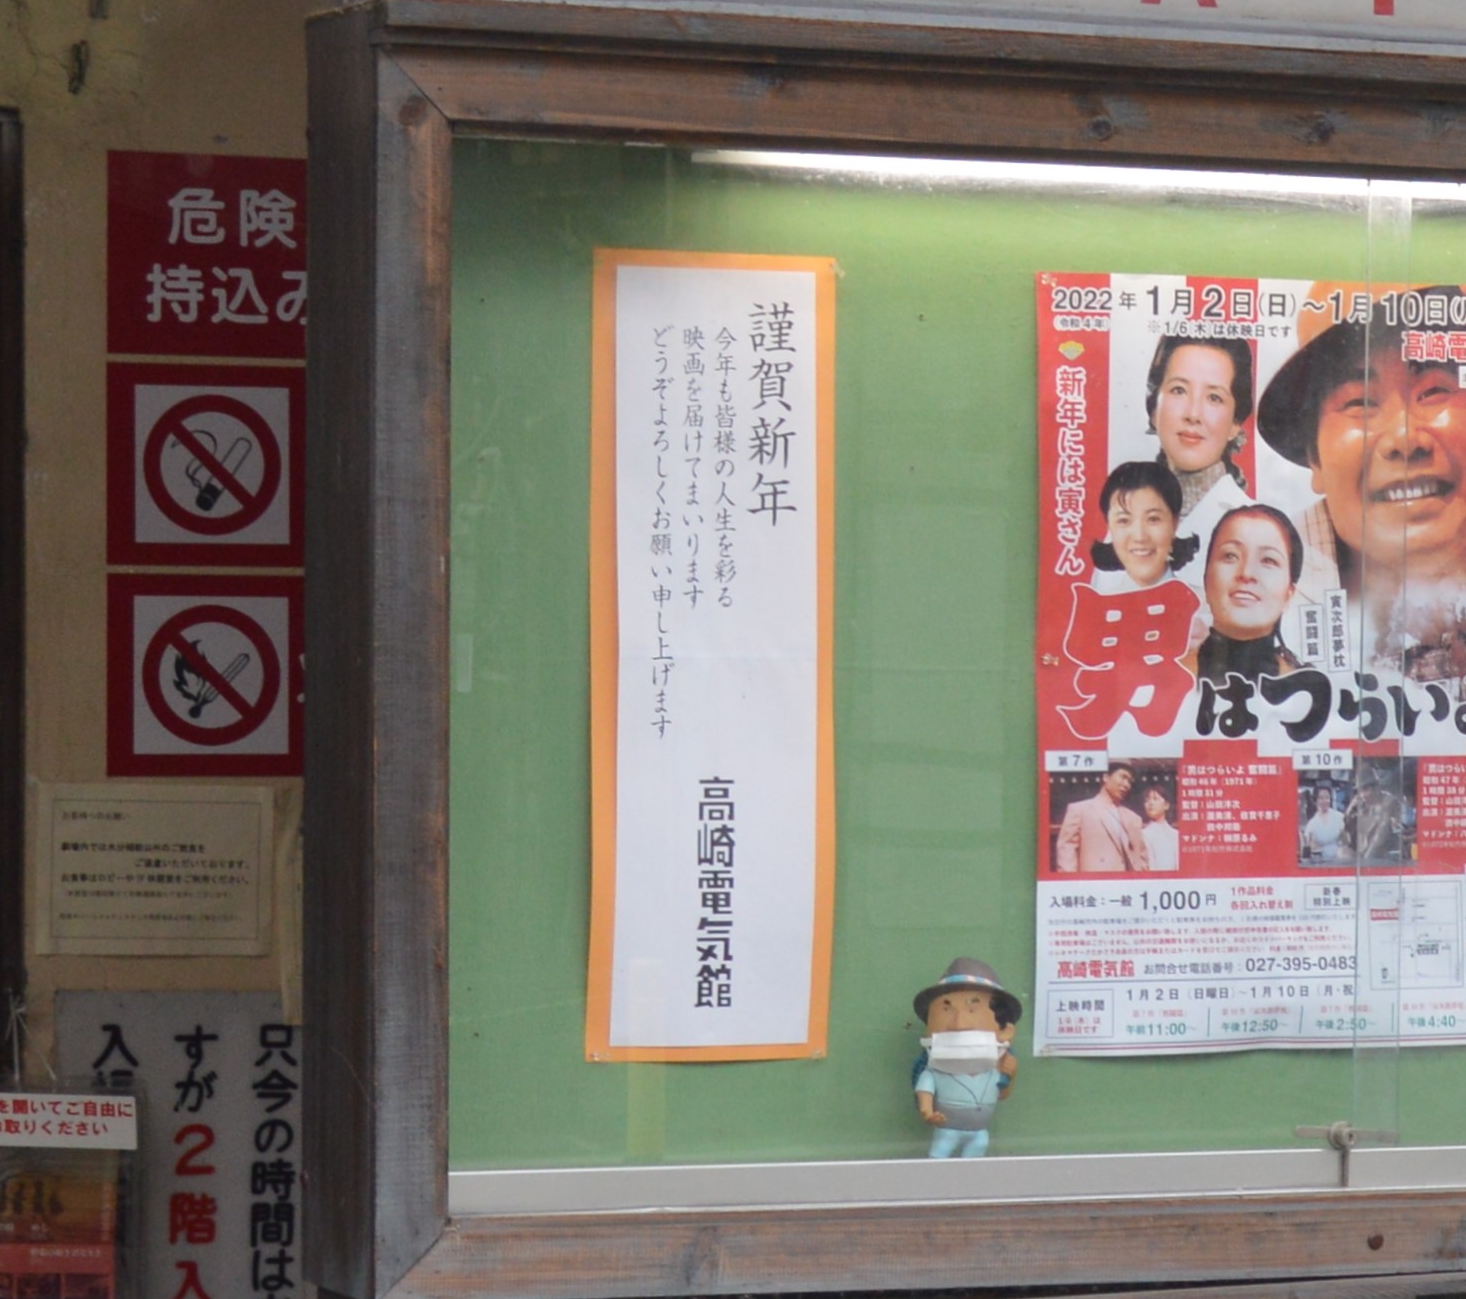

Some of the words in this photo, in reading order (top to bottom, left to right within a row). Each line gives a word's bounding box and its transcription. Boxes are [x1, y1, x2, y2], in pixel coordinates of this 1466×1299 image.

[167, 187, 298, 249] 危険
[681, 326, 706, 609] 映画を届けてまいります
[713, 326, 738, 609] 今年も皆様の人生を彩る
[746, 302, 799, 528] 謹賀新年
[1054, 366, 1086, 577] 新年には寅さん
[650, 326, 675, 740] どうぞよろしくお願い申し上げます
[1057, 754, 1095, 767] 第7作
[1301, 753, 1343, 766] 第10作
[694, 777, 735, 1010] 高崎電気館
[1054, 999, 1106, 1013] 上映時間
[1056, 959, 1136, 980] 高崎電気館
[1245, 954, 1358, 974] 027-395-0483
